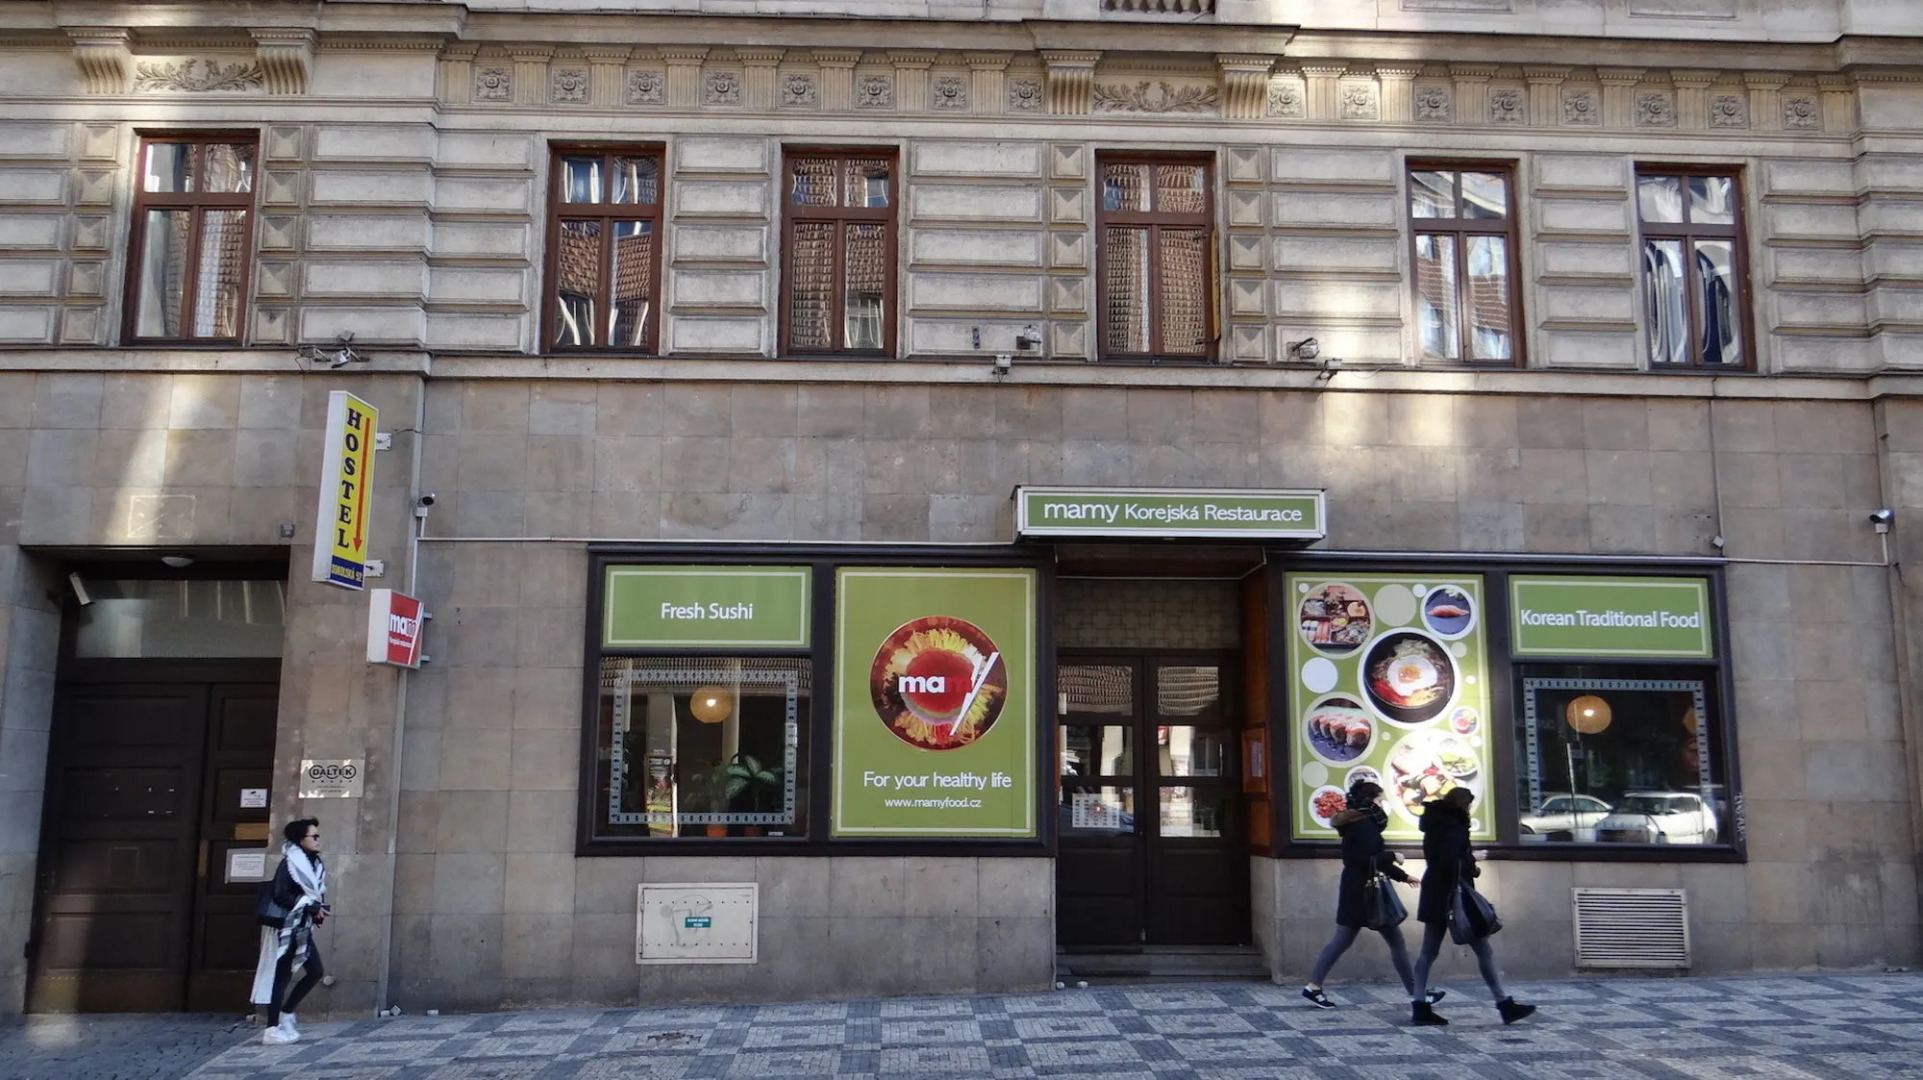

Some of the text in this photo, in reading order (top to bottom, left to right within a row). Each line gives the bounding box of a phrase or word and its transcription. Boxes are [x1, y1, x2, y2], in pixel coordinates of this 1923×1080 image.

[337, 408, 362, 549] HOSTEL
[1043, 502, 1303, 523] mamy Korejská Restaurace
[661, 602, 754, 619] Fresh Sushi
[1520, 609, 1700, 628] Korean Traditional Food
[863, 771, 1012, 790] For your healthy life
[884, 796, 982, 809] www.mamyfood.cz
